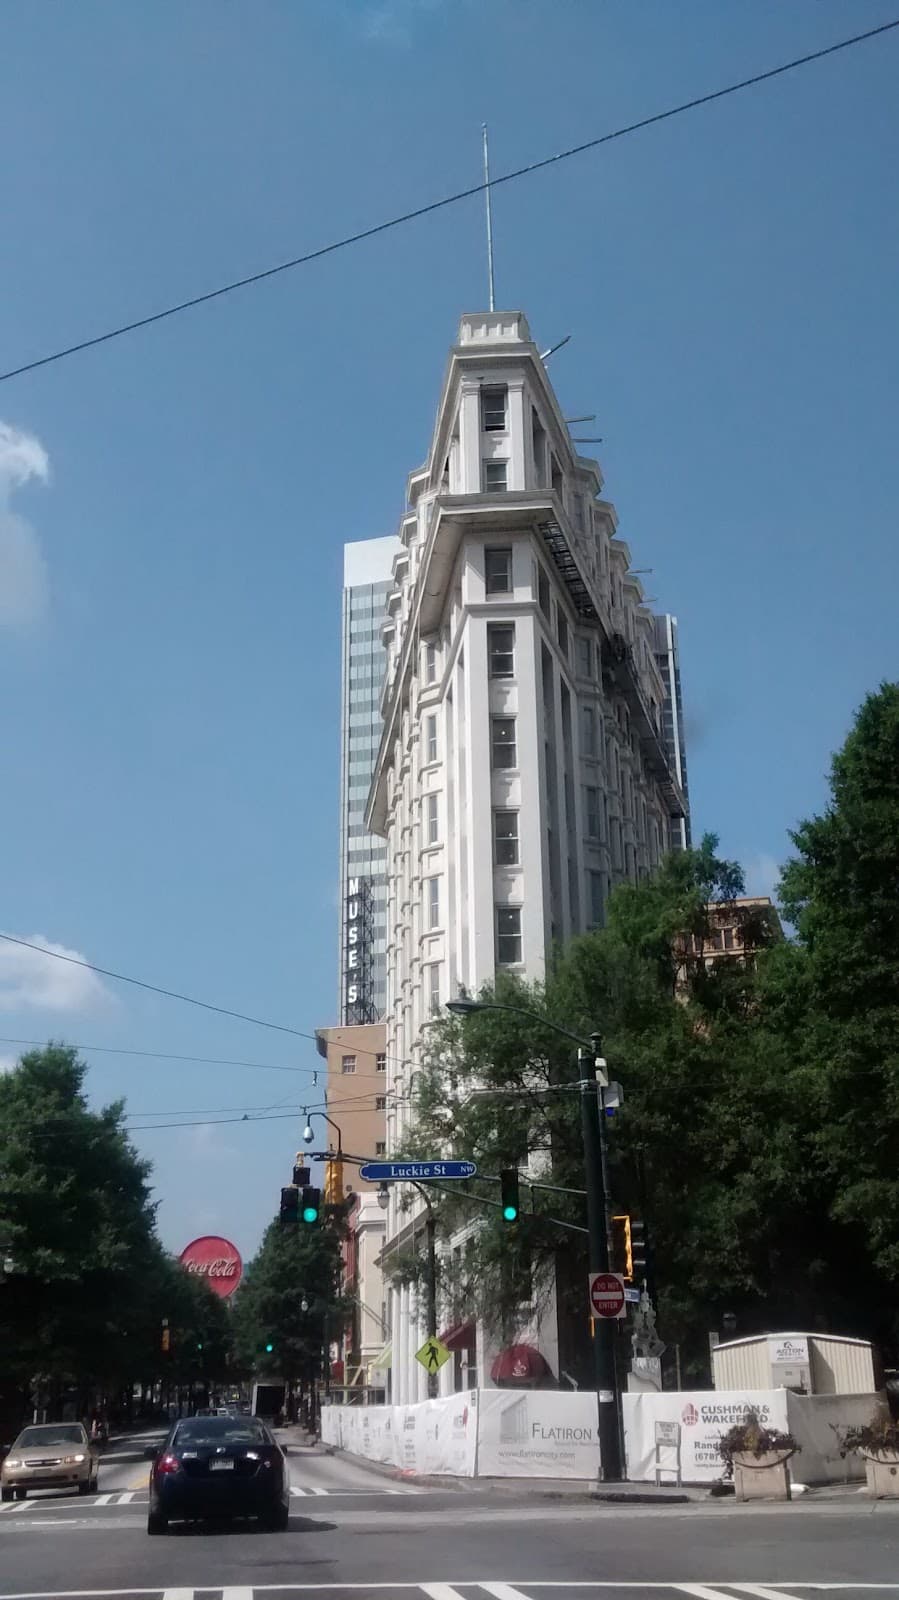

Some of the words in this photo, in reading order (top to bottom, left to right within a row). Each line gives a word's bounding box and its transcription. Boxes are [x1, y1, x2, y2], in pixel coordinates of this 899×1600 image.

[348, 878, 358, 1003] MUSE'S
[390, 1166, 430, 1177] Luckie
[433, 1164, 446, 1175] St
[460, 1165, 474, 1173] NW
[597, 1282, 606, 1290] DO
[608, 1282, 619, 1290] NOT
[598, 1301, 618, 1309] ENTER
[701, 1405, 760, 1414] CUSHMAN
[762, 1405, 770, 1414] &
[701, 1415, 769, 1424] WAKEFID
[532, 1422, 592, 1440] FLATIRON
